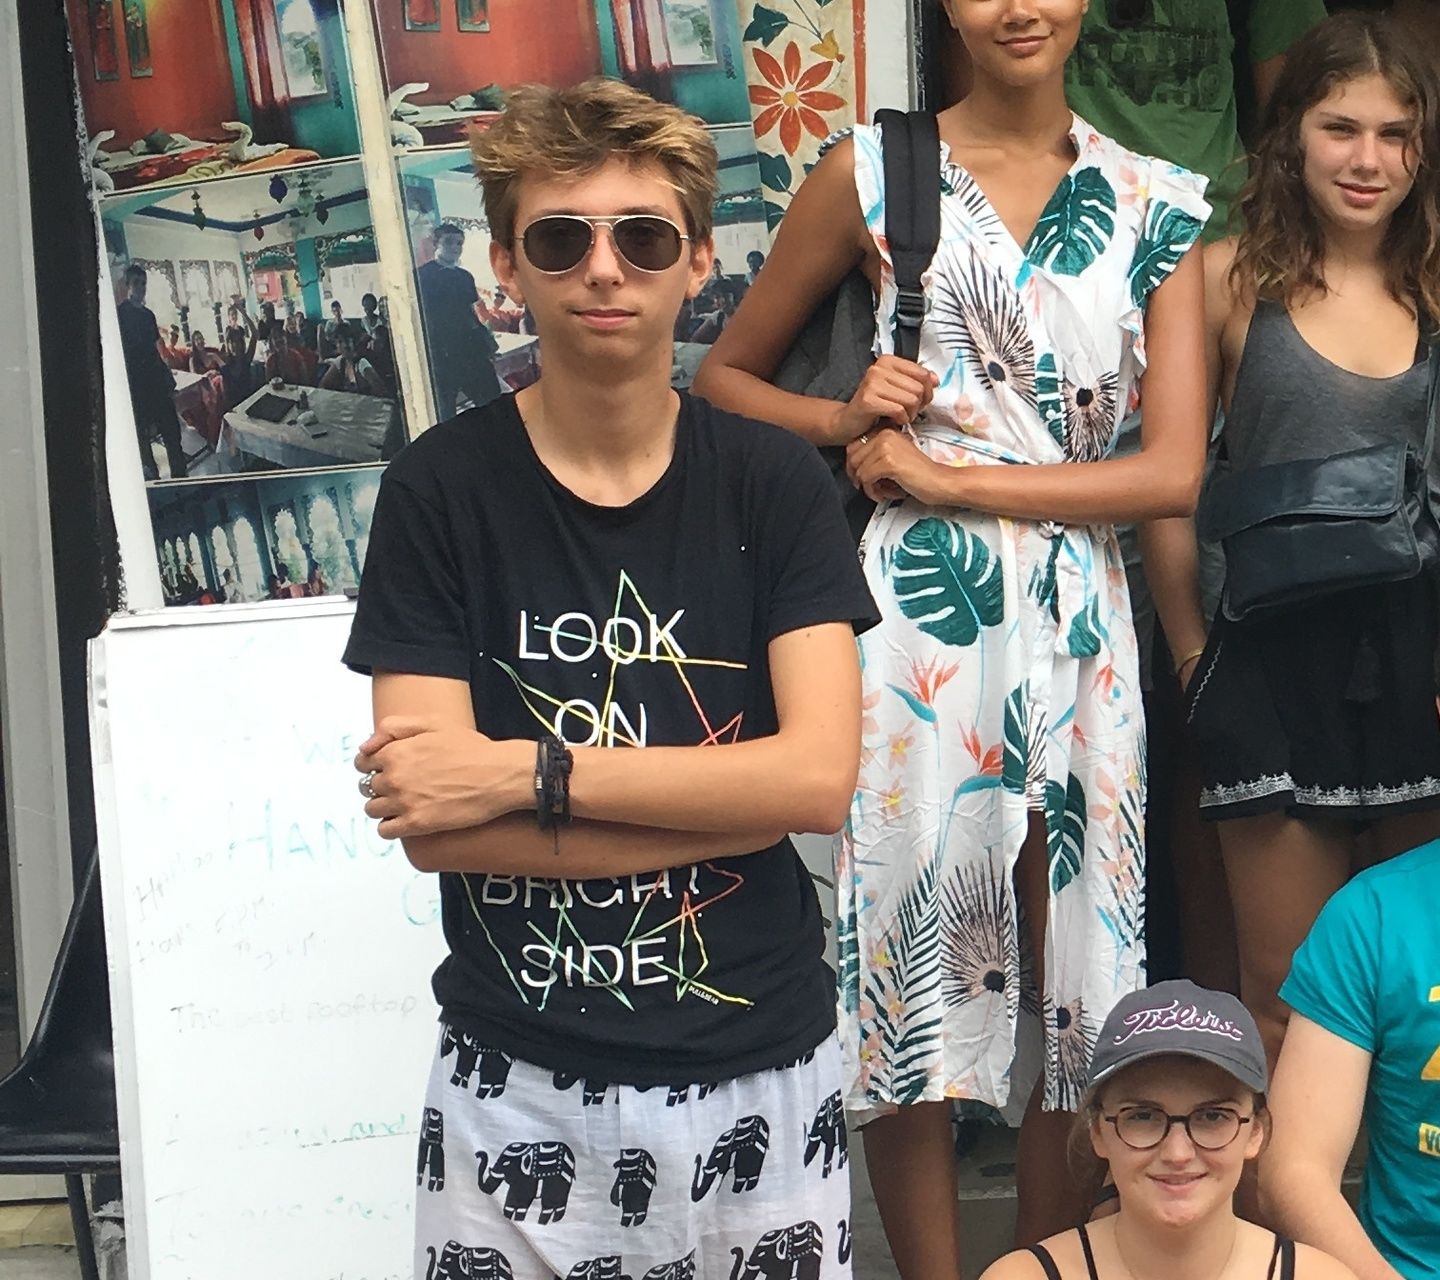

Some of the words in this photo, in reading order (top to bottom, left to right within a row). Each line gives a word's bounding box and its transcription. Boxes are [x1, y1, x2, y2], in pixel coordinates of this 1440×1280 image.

[519, 609, 687, 665] LOOK
[554, 698, 648, 748] ON
[520, 937, 669, 988] SIDE
